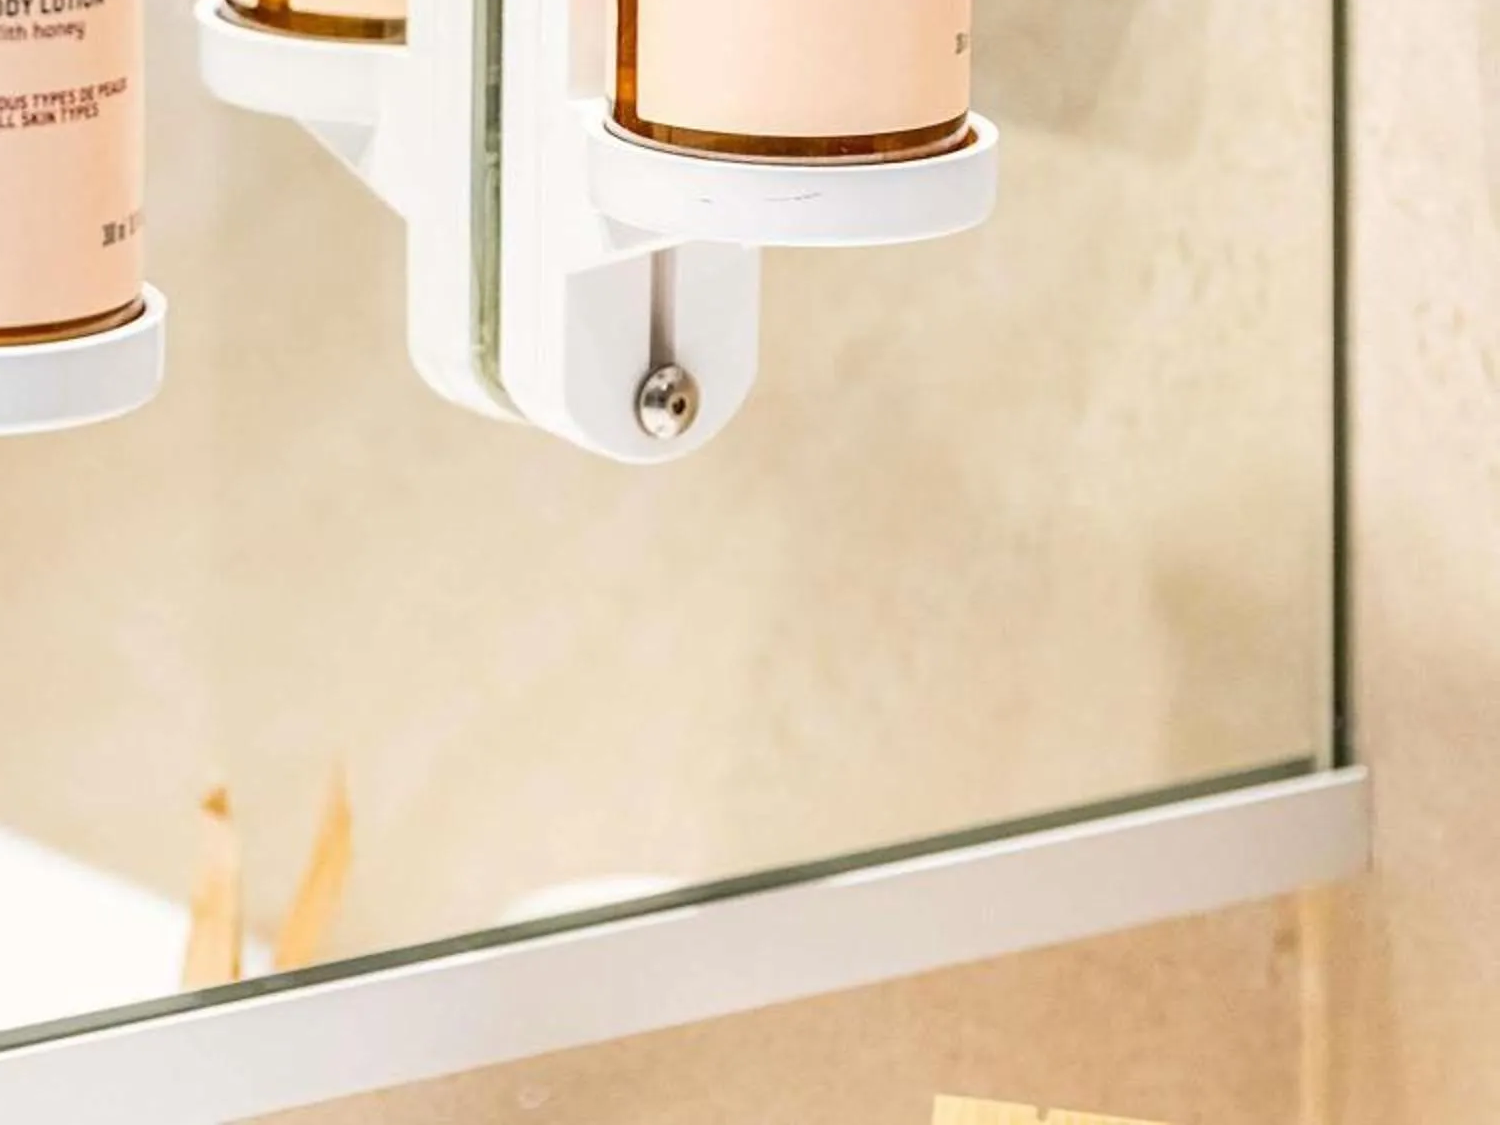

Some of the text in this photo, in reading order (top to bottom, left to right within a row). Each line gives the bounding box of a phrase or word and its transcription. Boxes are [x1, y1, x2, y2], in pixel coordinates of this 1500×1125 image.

[33, 21, 86, 41] honey
[32, 89, 76, 108] TYPES
[80, 85, 95, 103] DE
[21, 110, 56, 127] SKIN
[60, 103, 99, 123] TYPES
